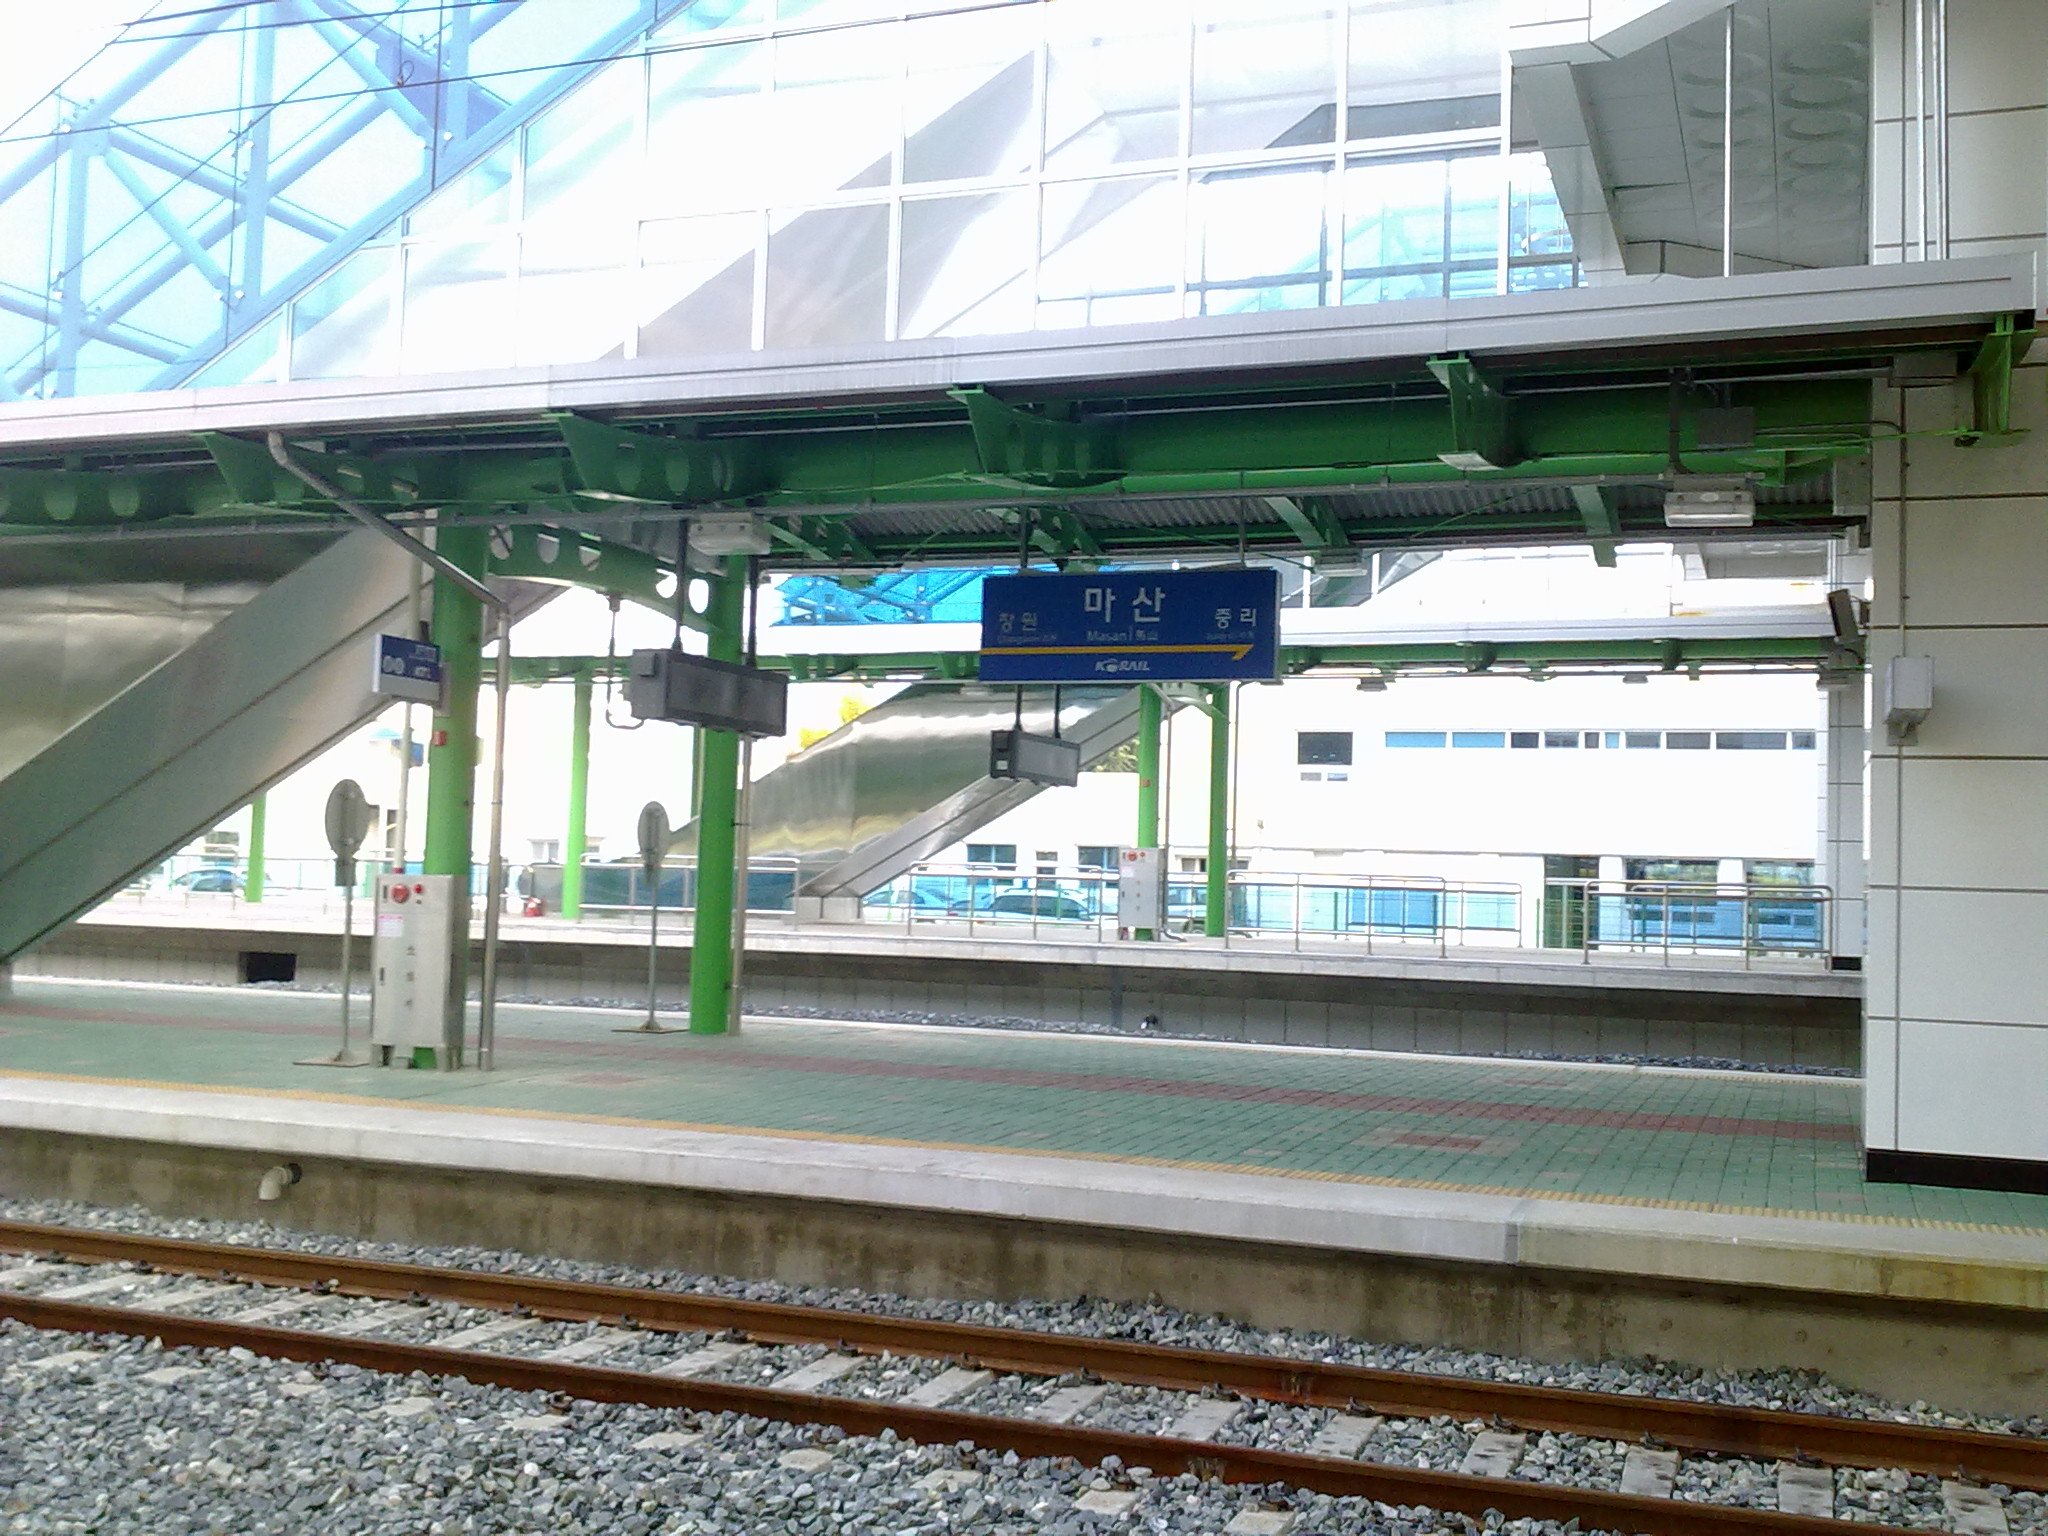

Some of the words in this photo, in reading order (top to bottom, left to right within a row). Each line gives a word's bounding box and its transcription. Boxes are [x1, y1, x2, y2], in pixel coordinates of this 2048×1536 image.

[1084, 586, 1166, 623] 마산
[1215, 608, 1257, 629] 중리
[1086, 630, 1128, 641] Masan
[1094, 658, 1151, 673] KORAIL
